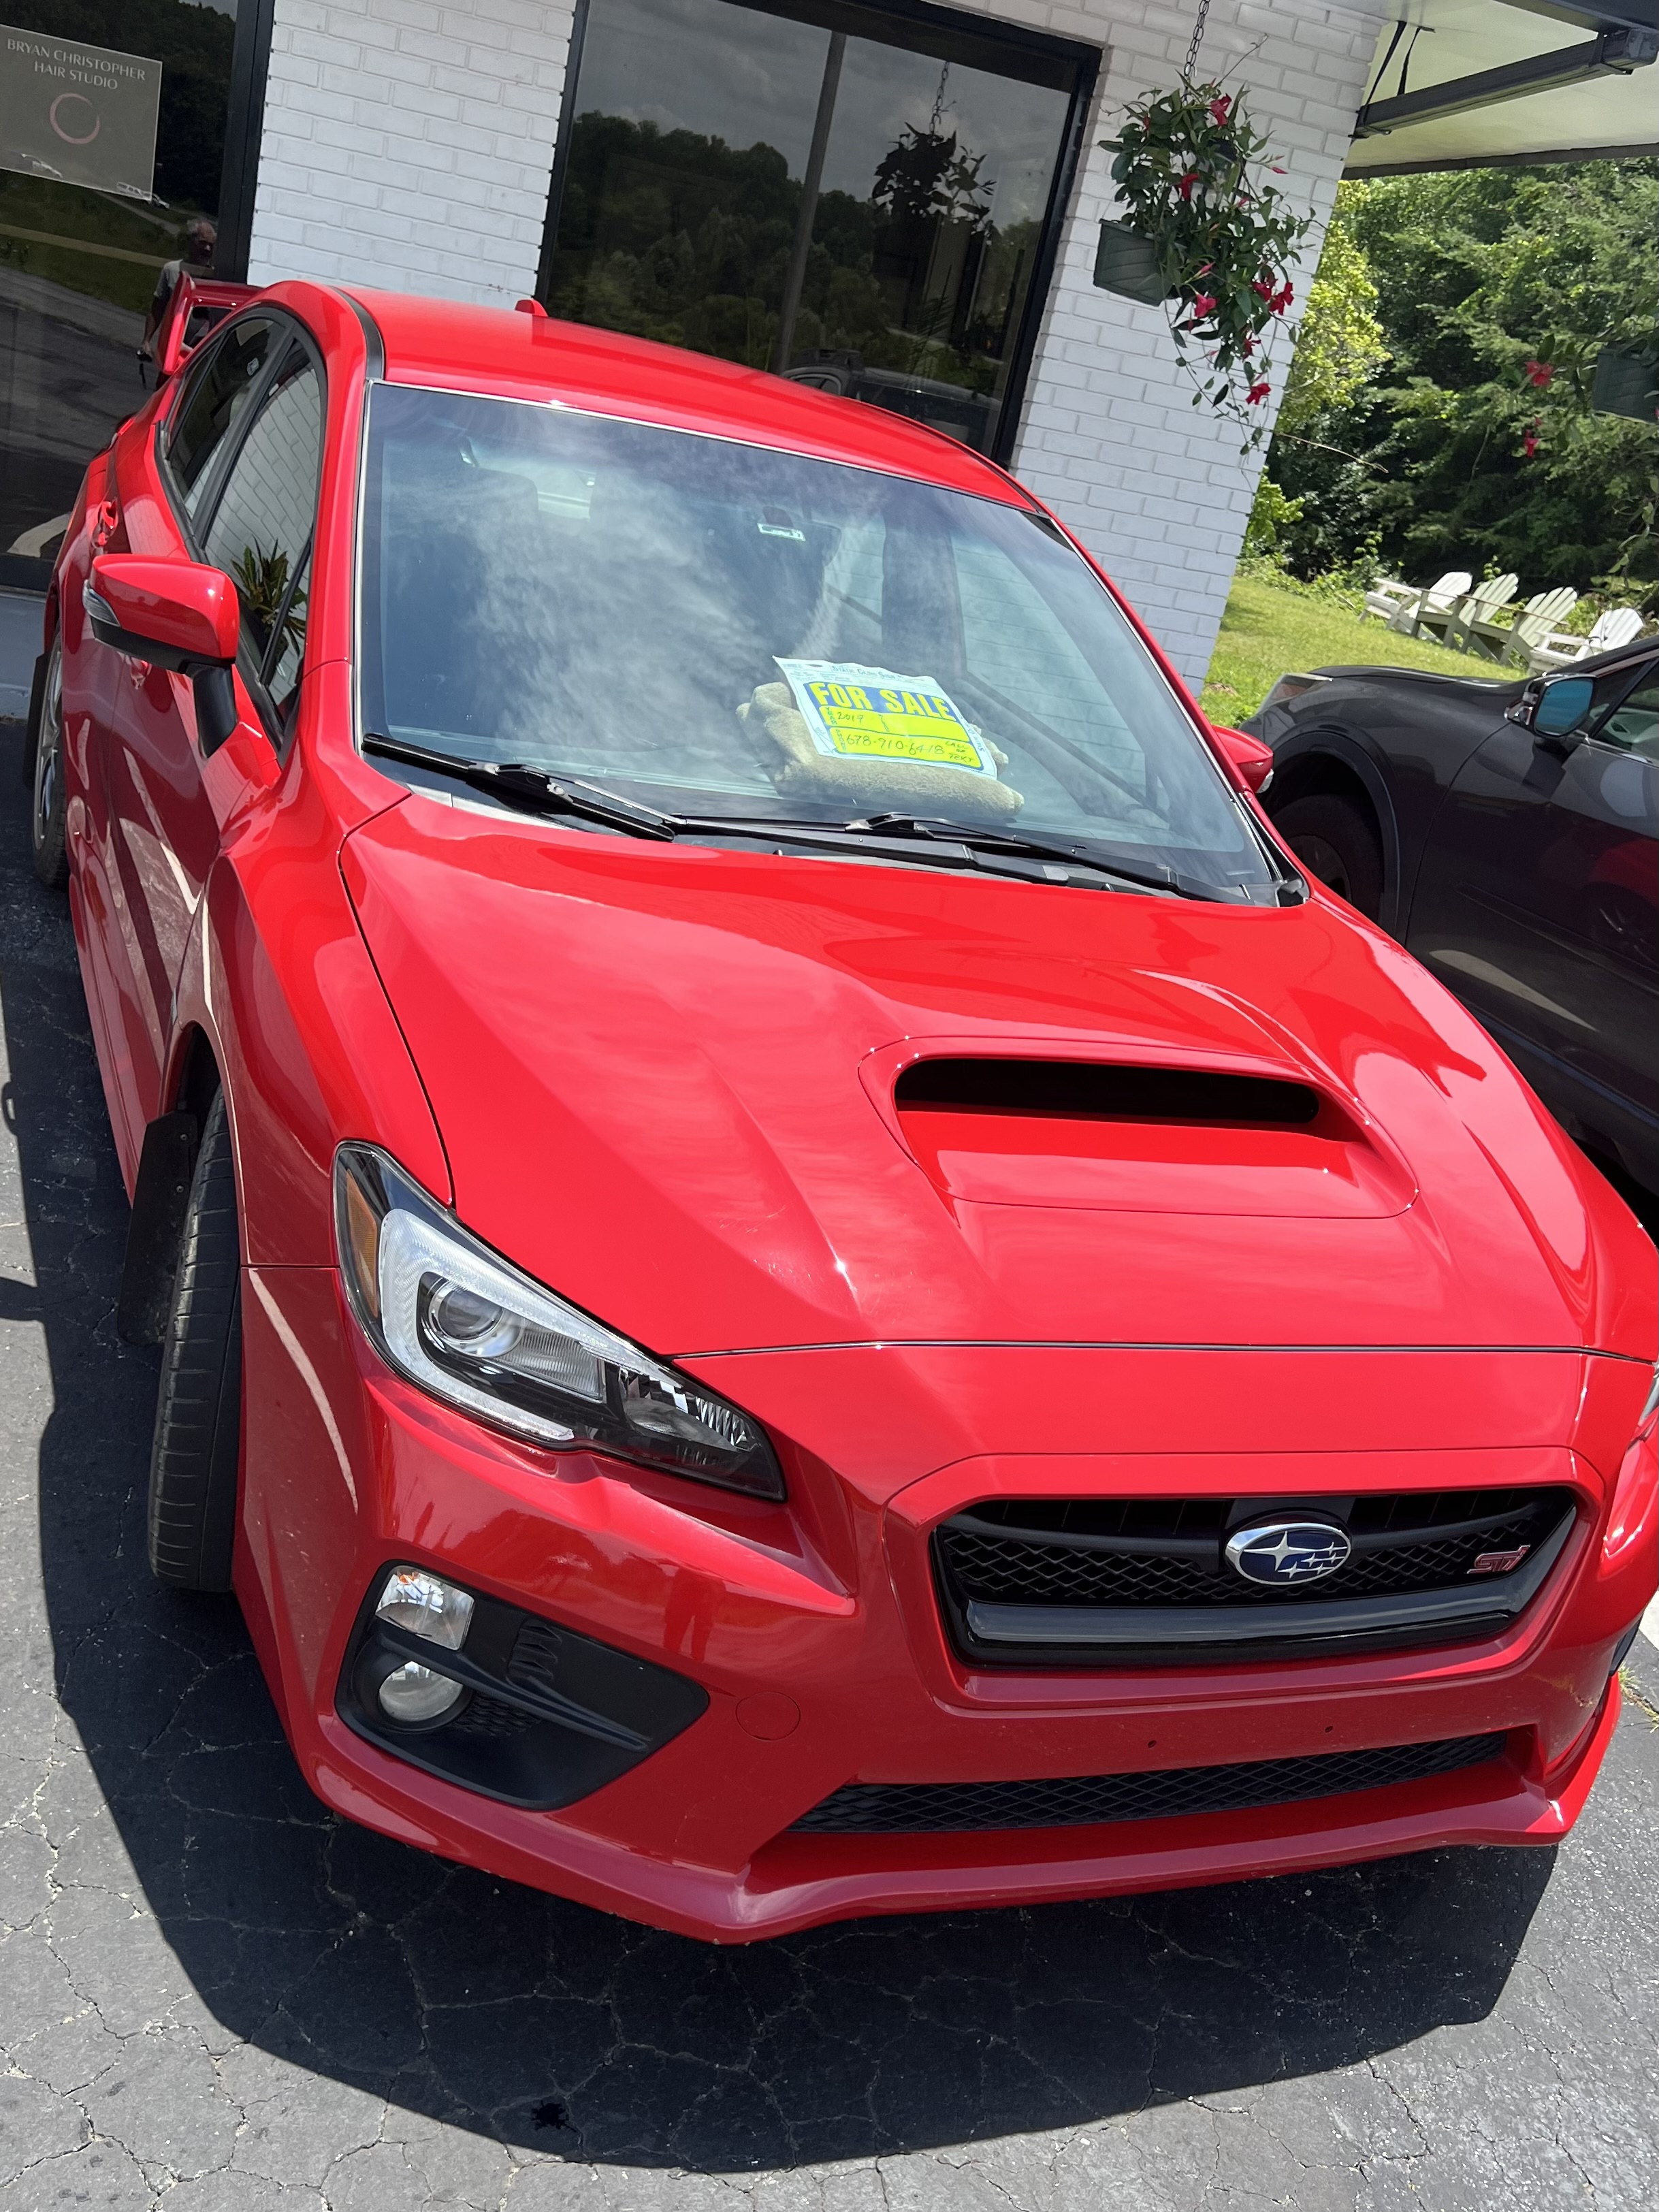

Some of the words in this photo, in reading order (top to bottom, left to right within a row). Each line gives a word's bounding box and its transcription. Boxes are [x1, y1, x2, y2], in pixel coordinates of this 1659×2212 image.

[7, 38, 50, 58] BRYAN
[54, 50, 146, 80] CHRISTOPHER
[34, 61, 65, 78] HAIR
[69, 70, 118, 90] STUDIO
[809, 682, 873, 710] FOR
[880, 689, 956, 722] SALE
[837, 711, 864, 725] 2017
